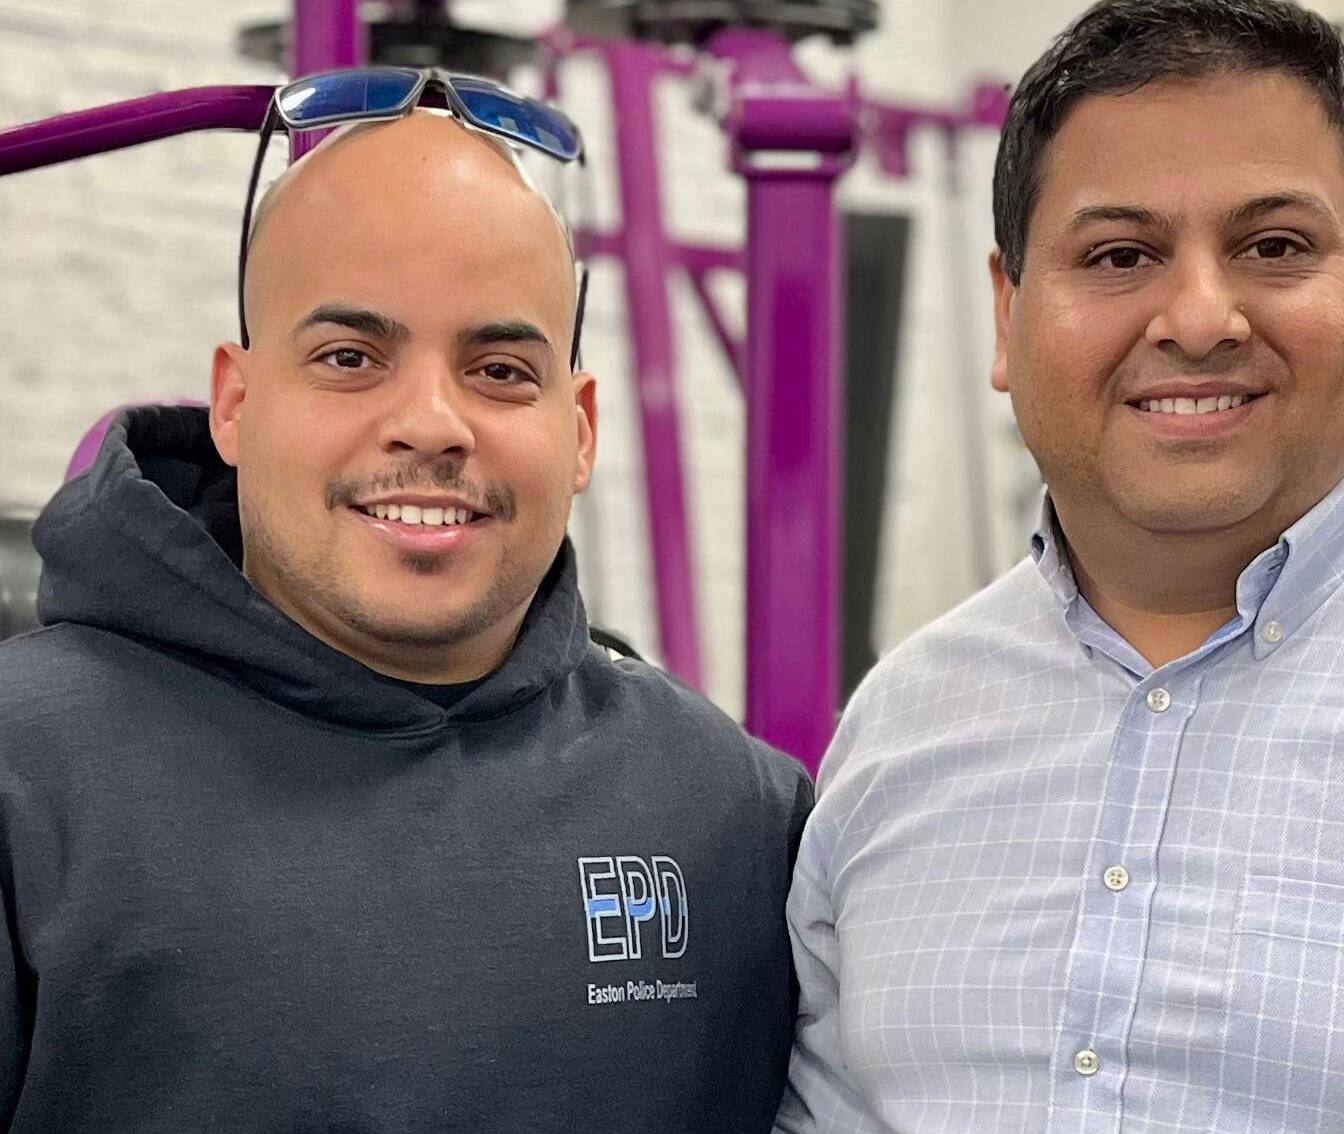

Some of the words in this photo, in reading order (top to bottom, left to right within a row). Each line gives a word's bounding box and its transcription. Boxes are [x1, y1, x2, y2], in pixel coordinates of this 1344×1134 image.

[578, 856, 689, 962] EPD
[588, 984, 626, 1004] Easton
[627, 980, 655, 1001] Police
